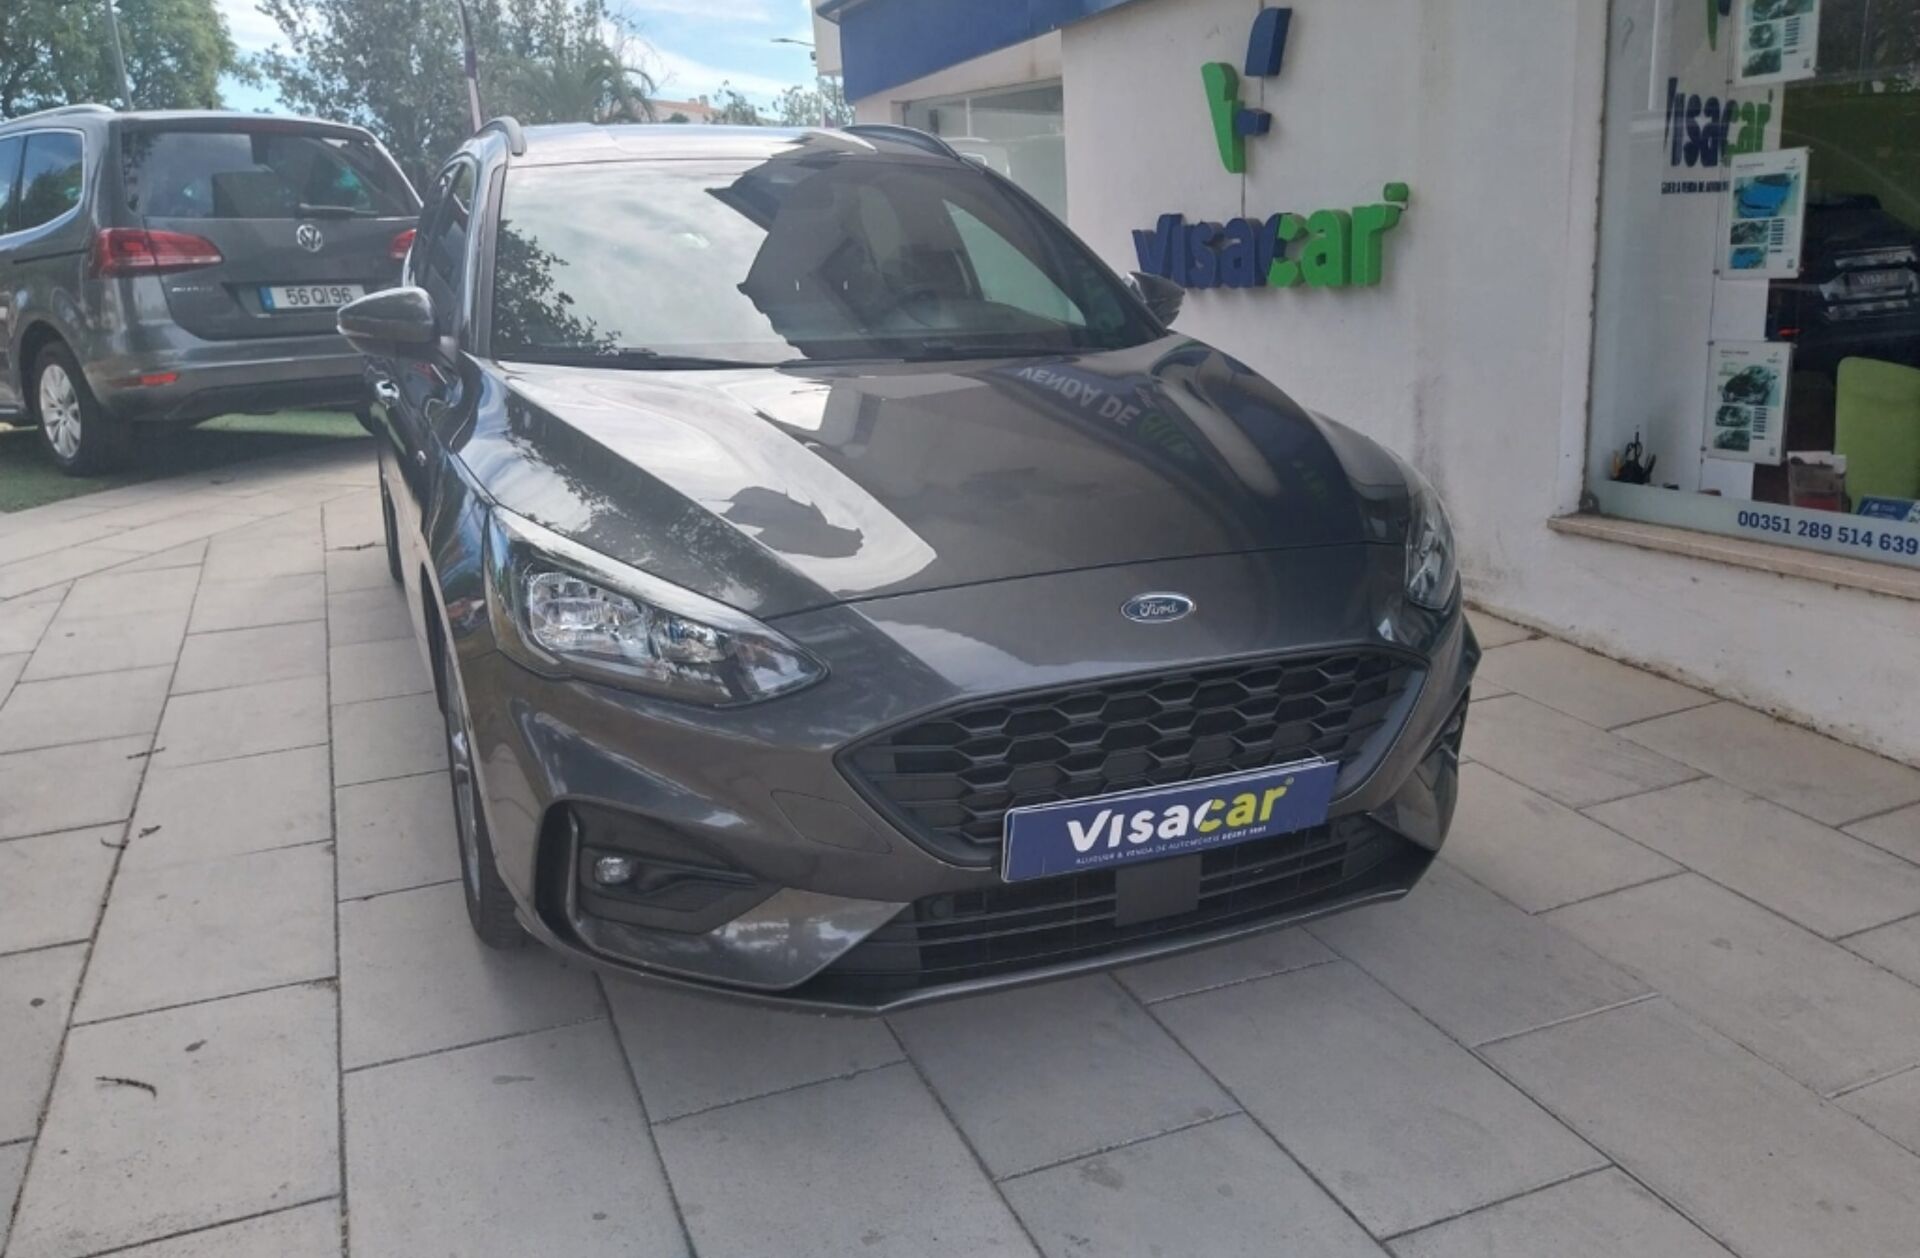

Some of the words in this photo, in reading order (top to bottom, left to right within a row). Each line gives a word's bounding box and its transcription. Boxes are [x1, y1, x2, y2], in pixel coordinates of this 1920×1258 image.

[1737, 510, 1792, 534] 00351
[1797, 519, 1833, 540] 289
[1837, 527, 1873, 548] 514
[1878, 533, 1919, 555] 639
[1140, 600, 1178, 616] Ford
